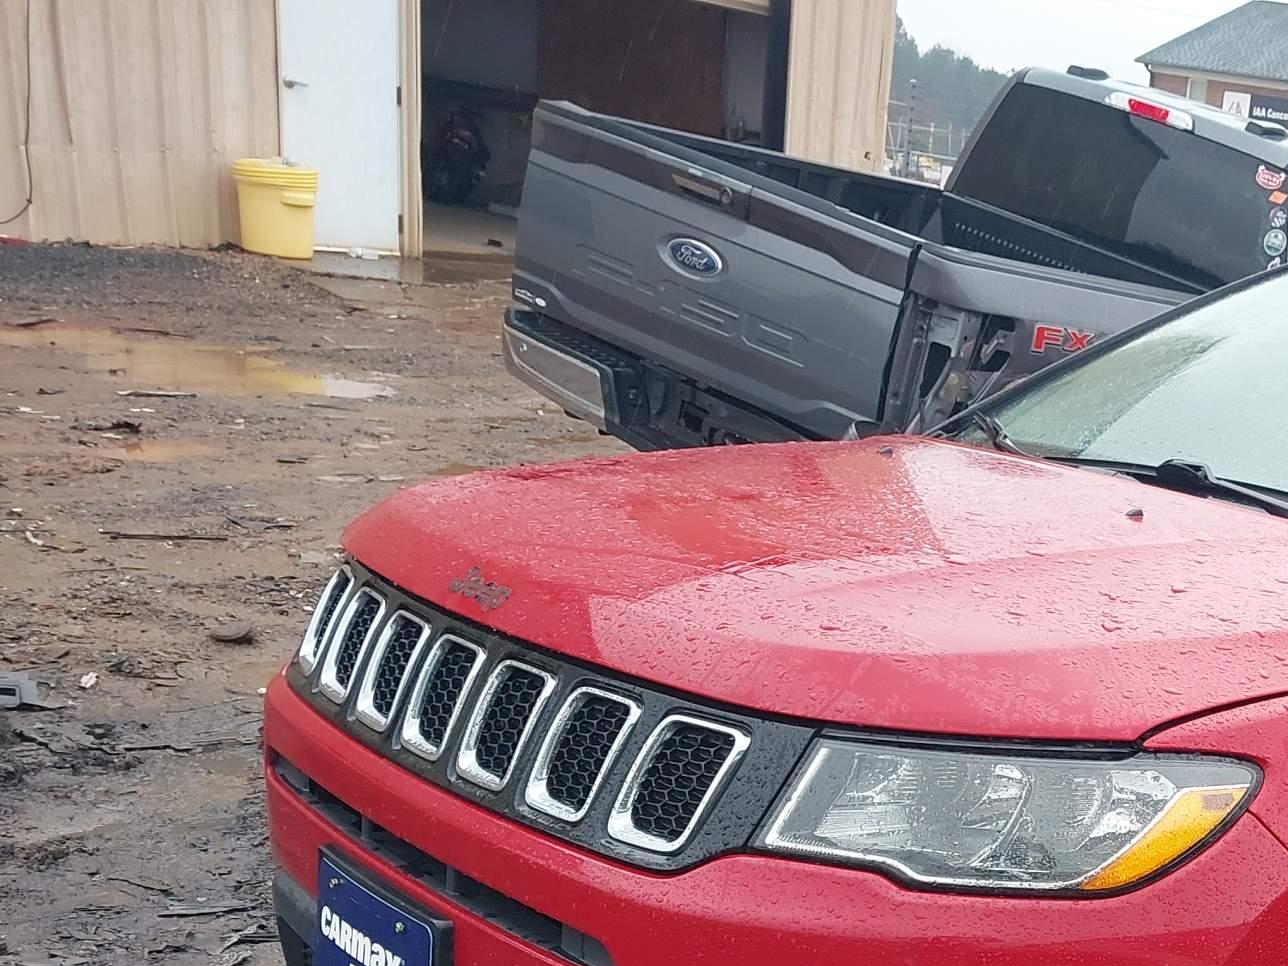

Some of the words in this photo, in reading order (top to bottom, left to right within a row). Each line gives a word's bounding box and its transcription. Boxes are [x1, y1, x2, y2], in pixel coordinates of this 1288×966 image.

[1253, 106, 1266, 118] IAA
[676, 244, 708, 271] Ford
[448, 565, 513, 610] Jeep
